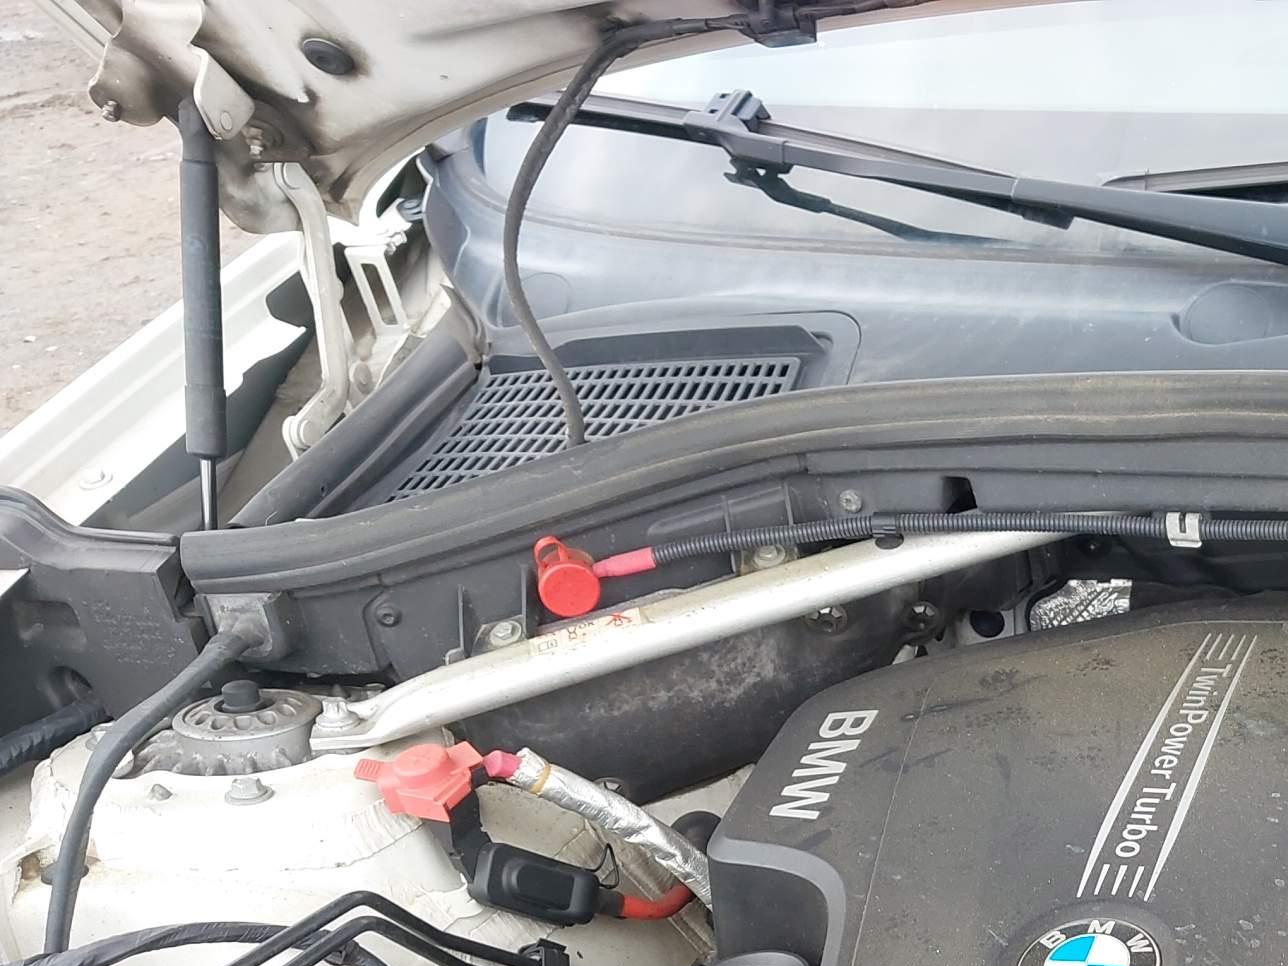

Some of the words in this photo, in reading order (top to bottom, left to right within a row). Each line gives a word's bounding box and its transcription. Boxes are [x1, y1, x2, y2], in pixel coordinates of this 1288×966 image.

[769, 709, 879, 820] BMW
[1151, 663, 1232, 781] TwinPower
[1116, 781, 1177, 858] Turbo
[1040, 920, 1154, 955] BMW
